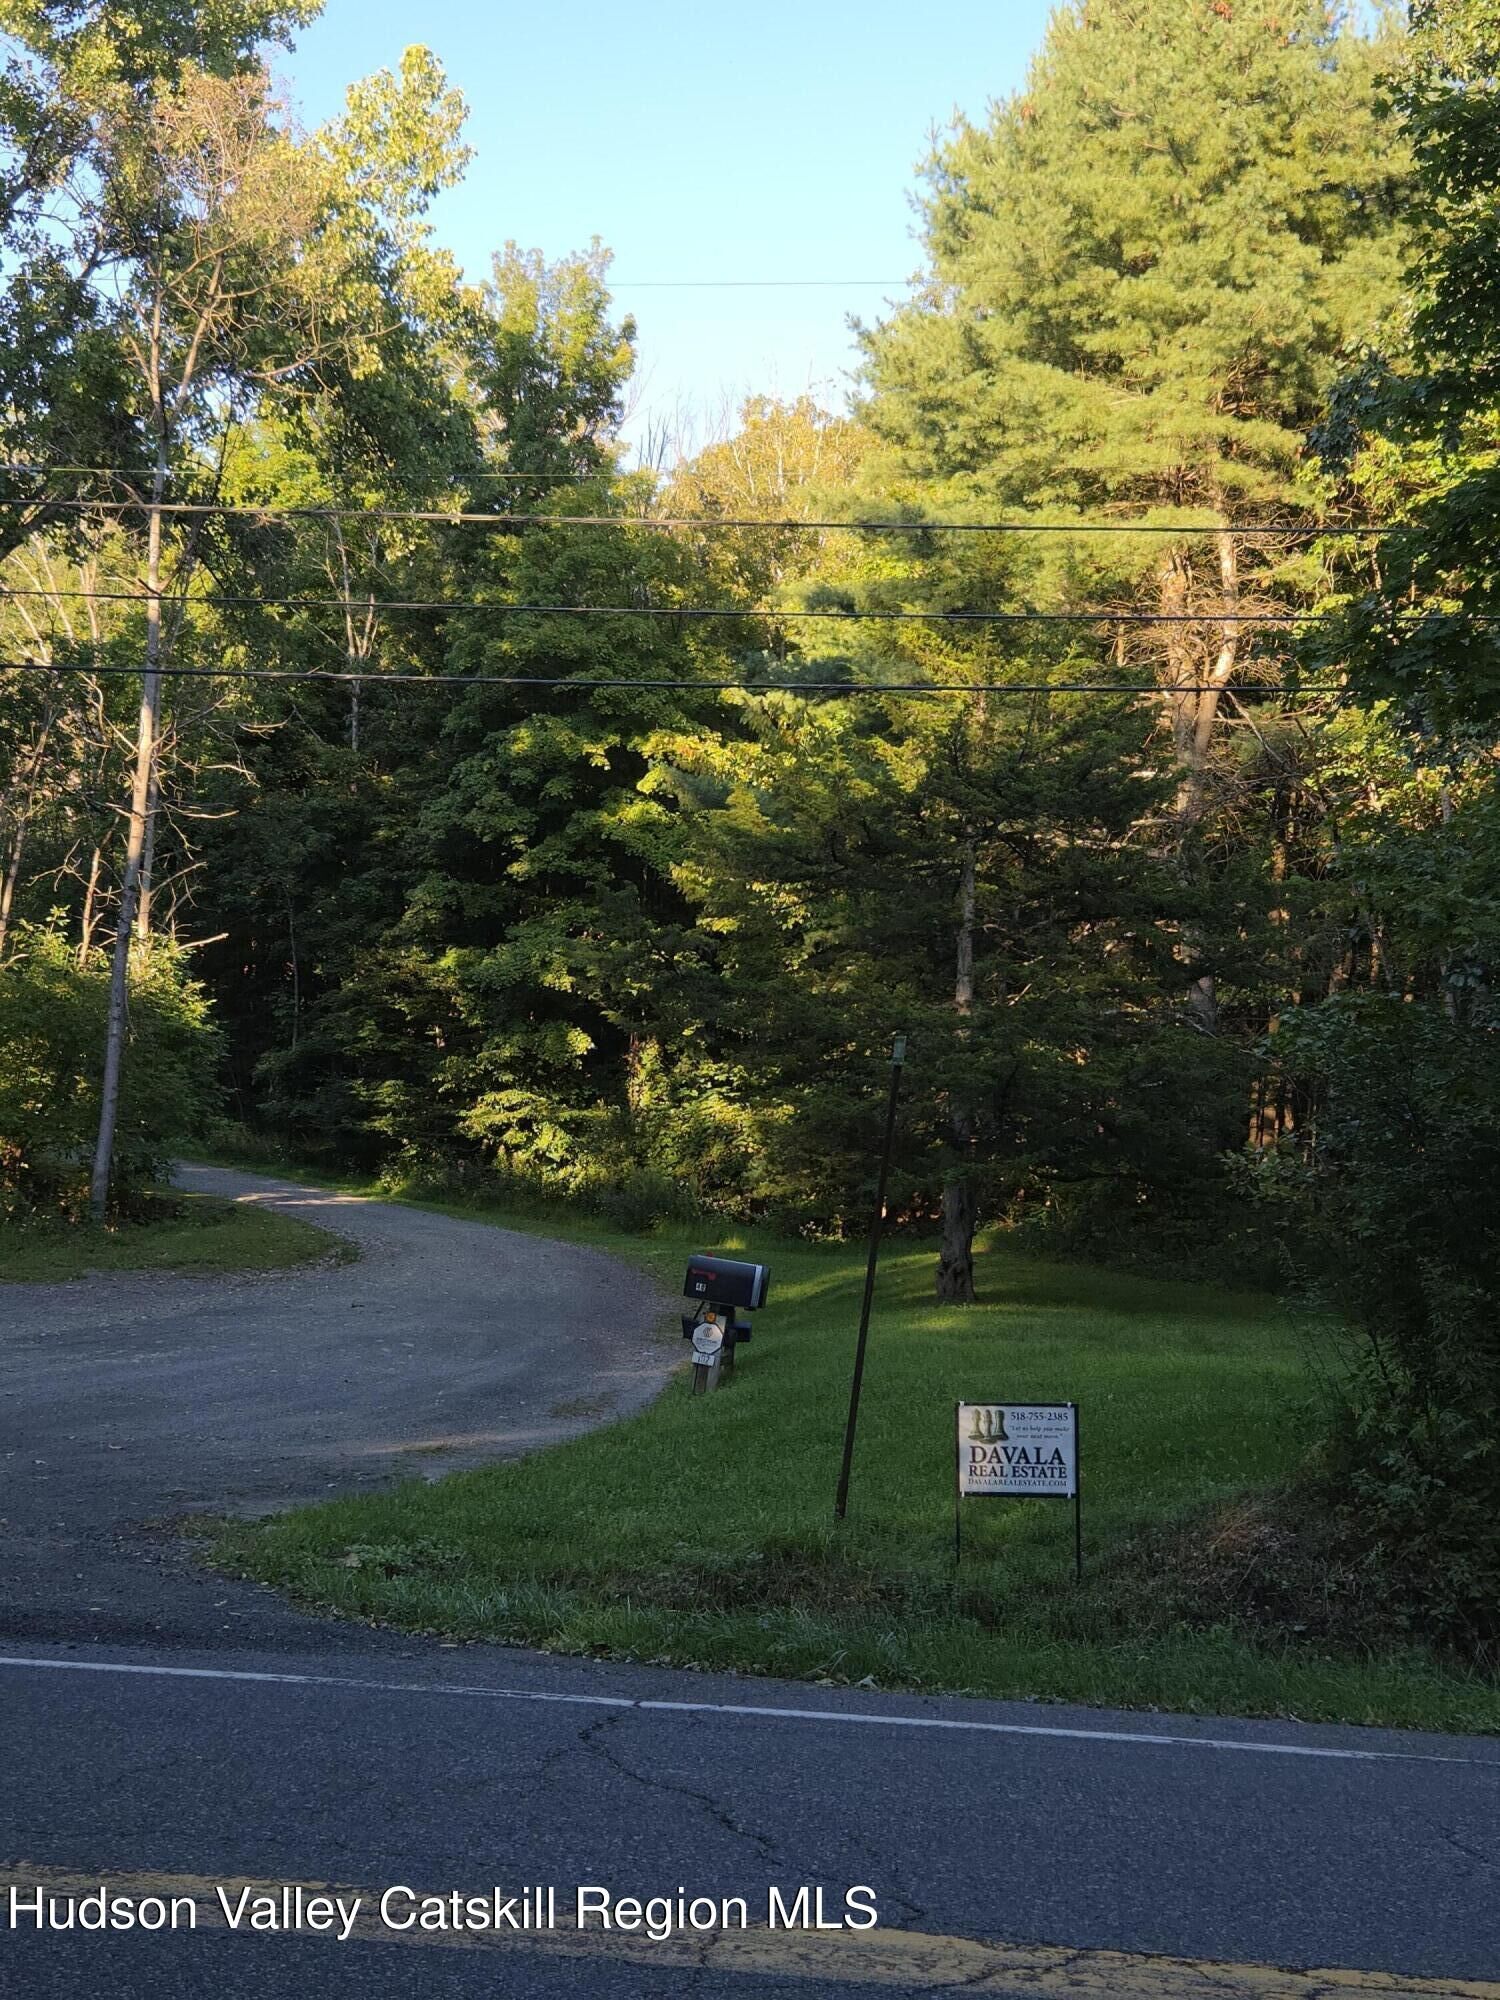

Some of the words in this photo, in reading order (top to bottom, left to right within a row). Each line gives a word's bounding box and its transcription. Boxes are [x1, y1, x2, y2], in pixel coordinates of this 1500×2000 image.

[1010, 1411, 1069, 1421] 518-755-2385
[969, 1446, 1066, 1465] DAVALA
[969, 1465, 1008, 1478] REAL
[1011, 1466, 1067, 1479] ESTATE
